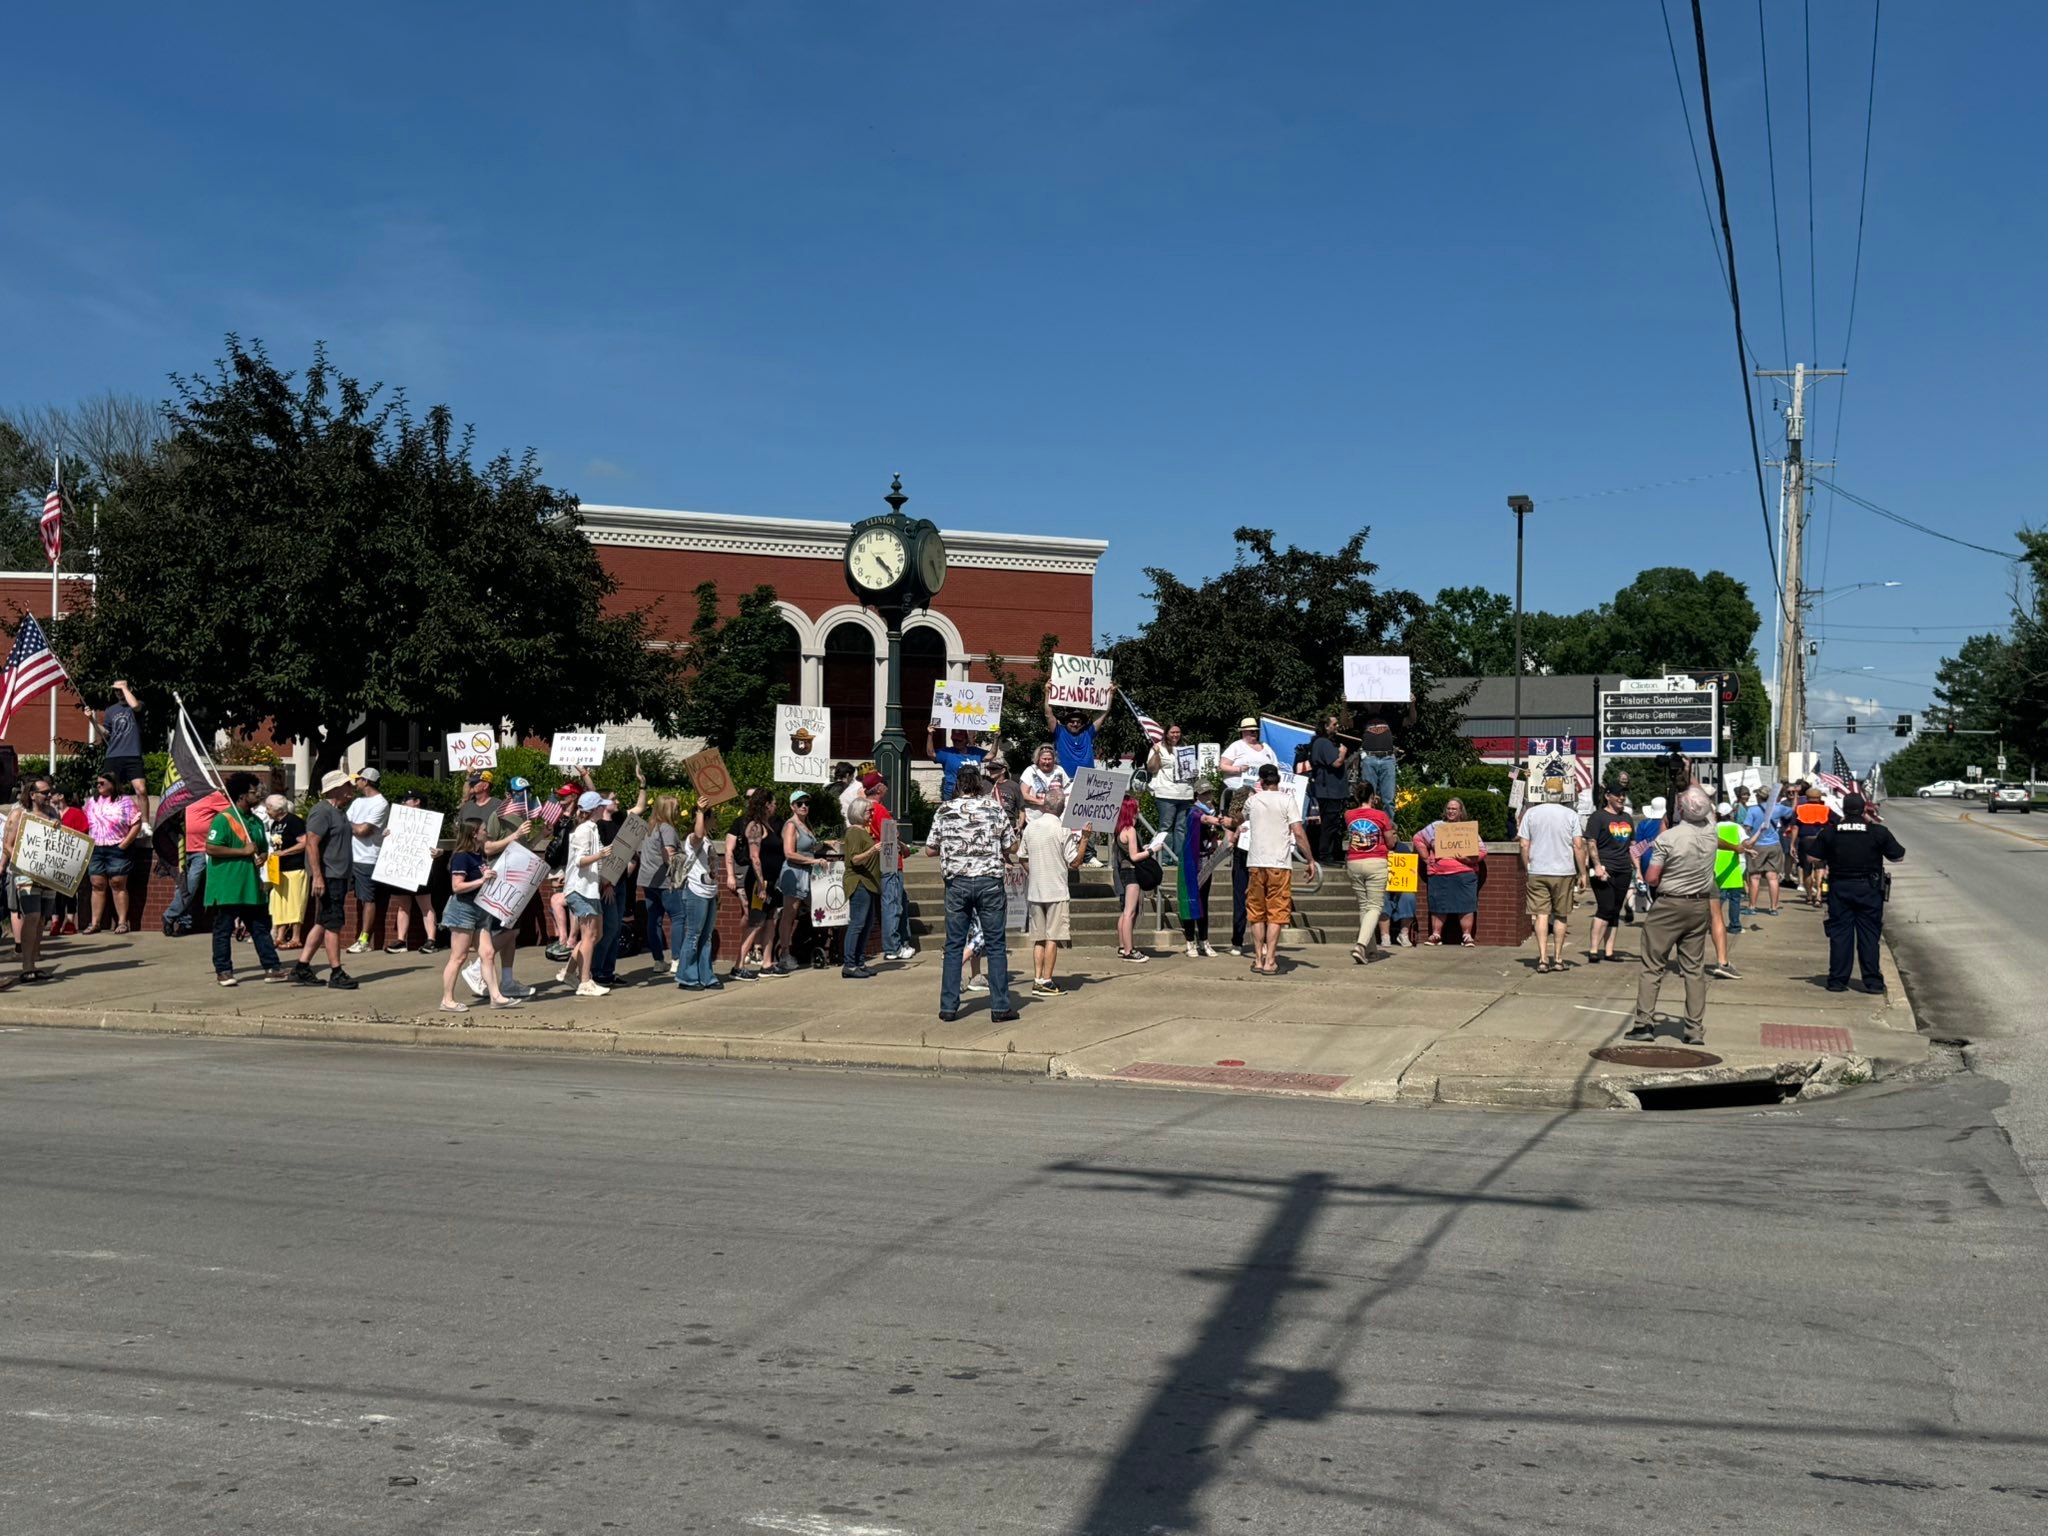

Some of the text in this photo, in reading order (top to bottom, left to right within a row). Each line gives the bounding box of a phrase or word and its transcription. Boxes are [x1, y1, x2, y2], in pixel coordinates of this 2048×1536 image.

[865, 517, 897, 527] CLINTON
[1053, 656, 1112, 678] HONK!!
[1078, 676, 1096, 686] FOR
[958, 688, 974, 700] NO
[1049, 683, 1111, 707] DEMOCRACY
[1620, 695, 1694, 705] Historic Downtown
[784, 705, 823, 721] ONLY YOU
[953, 713, 988, 725] KINGS
[1621, 710, 1678, 720] Visitors Center
[1620, 726, 1687, 736] Museum Complex
[450, 739, 466, 755] NO
[458, 754, 493, 769] KINGS
[780, 756, 829, 778] FASCISM
[1086, 773, 1114, 791] Where's
[399, 807, 433, 825] HATE
[1072, 802, 1120, 822] CONGRESS?
[44, 826, 57, 839] WE
[208, 829, 217, 840] 3
[403, 822, 430, 836] WILL
[1837, 823, 1867, 831] POLICE
[26, 834, 82, 861] WE RESIST!
[391, 832, 431, 848] NEVER
[1439, 839, 1471, 850] LOVE!!
[394, 843, 425, 857] MAKE
[22, 848, 67, 869] WE RAISE
[381, 850, 424, 868] AMERICA
[29, 859, 47, 875] OUR
[384, 862, 423, 879] GREAT
